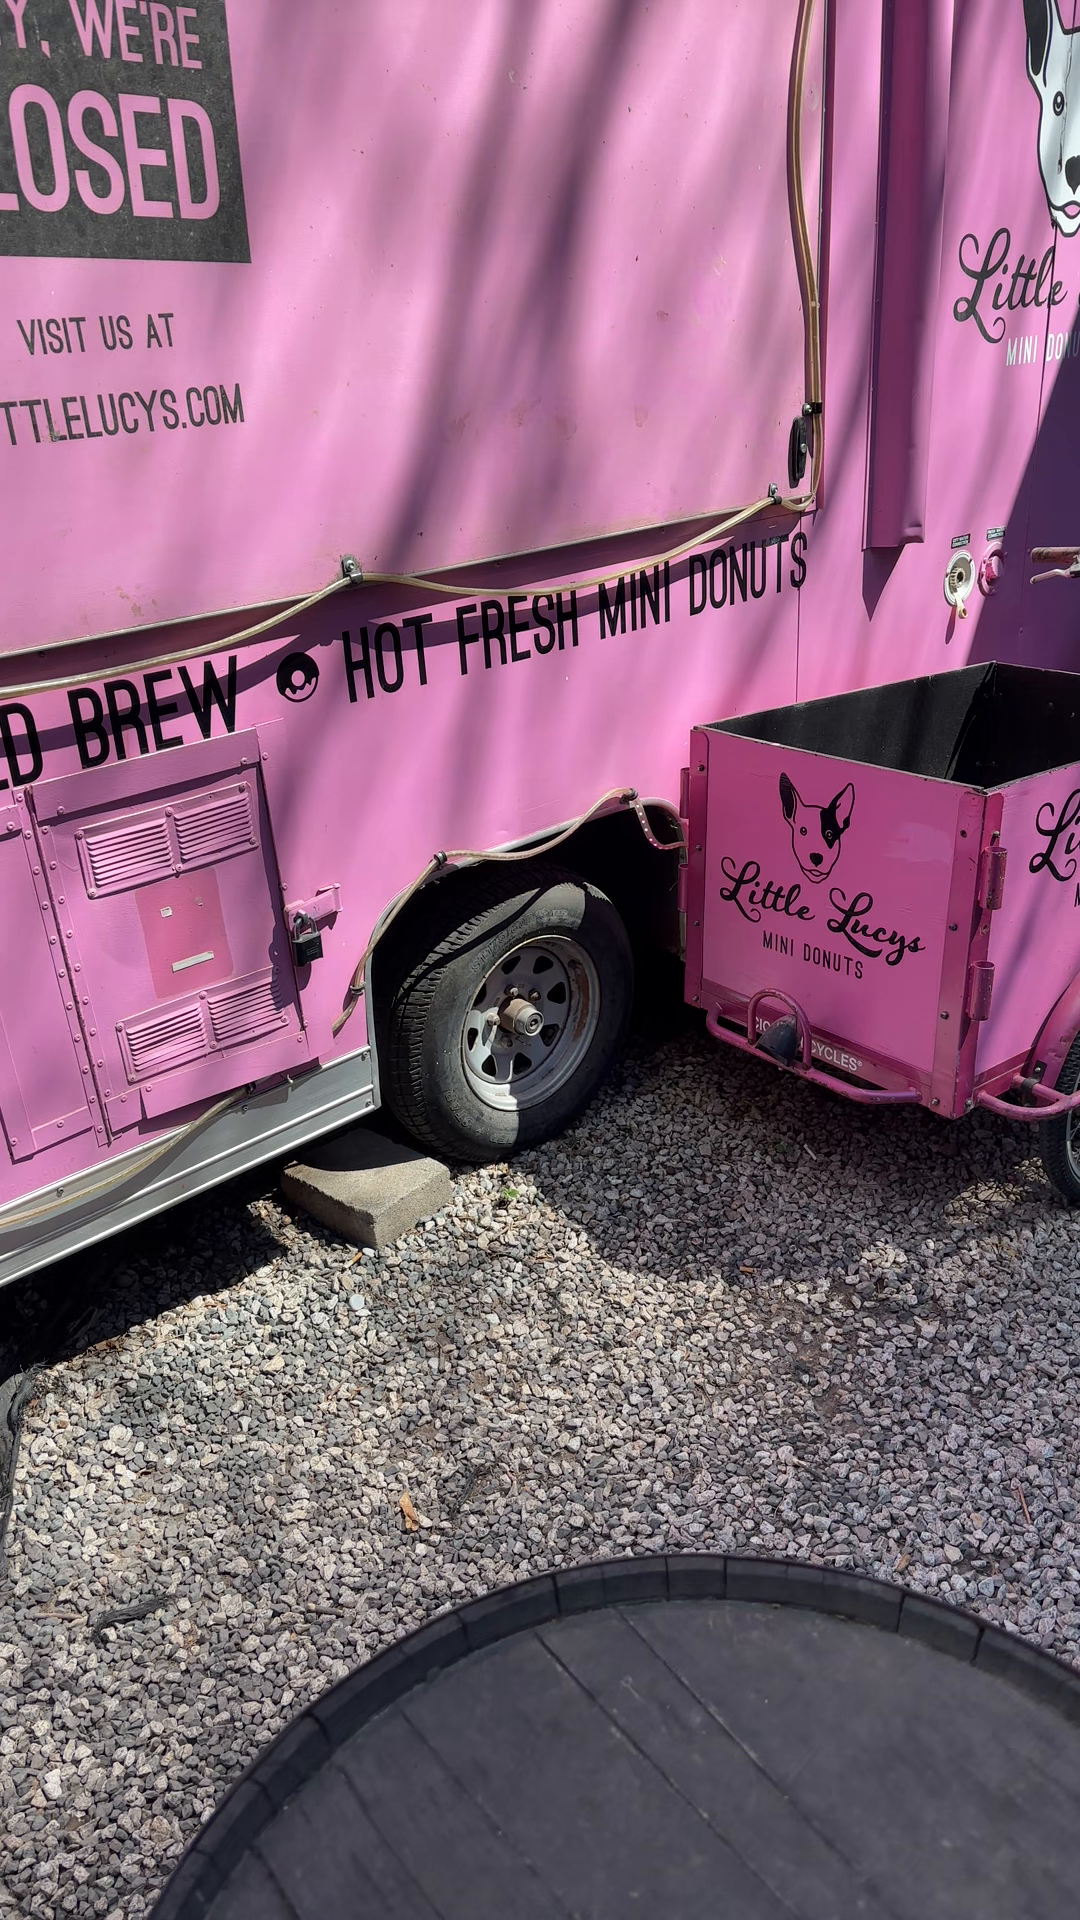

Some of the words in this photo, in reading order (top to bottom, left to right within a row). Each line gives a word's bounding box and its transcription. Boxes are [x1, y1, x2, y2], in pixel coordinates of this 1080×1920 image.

[68, 0, 202, 69] WE'RE
[951, 227, 1068, 343] Little
[17, 317, 86, 356] VISIT
[99, 315, 133, 351] US
[147, 313, 174, 348] AT
[1006, 335, 1038, 366] MINI
[0, 383, 245, 446] TTLELUCYS.COM
[341, 613, 433, 703] HOT
[455, 590, 579, 676] FRESH
[598, 561, 670, 640] MINI
[689, 532, 807, 617] DONUTS
[67, 655, 237, 770] BREW
[720, 857, 815, 923] Little
[827, 887, 926, 966] Lucys
[763, 930, 794, 957] MINI
[803, 943, 863, 979] DONUTS
